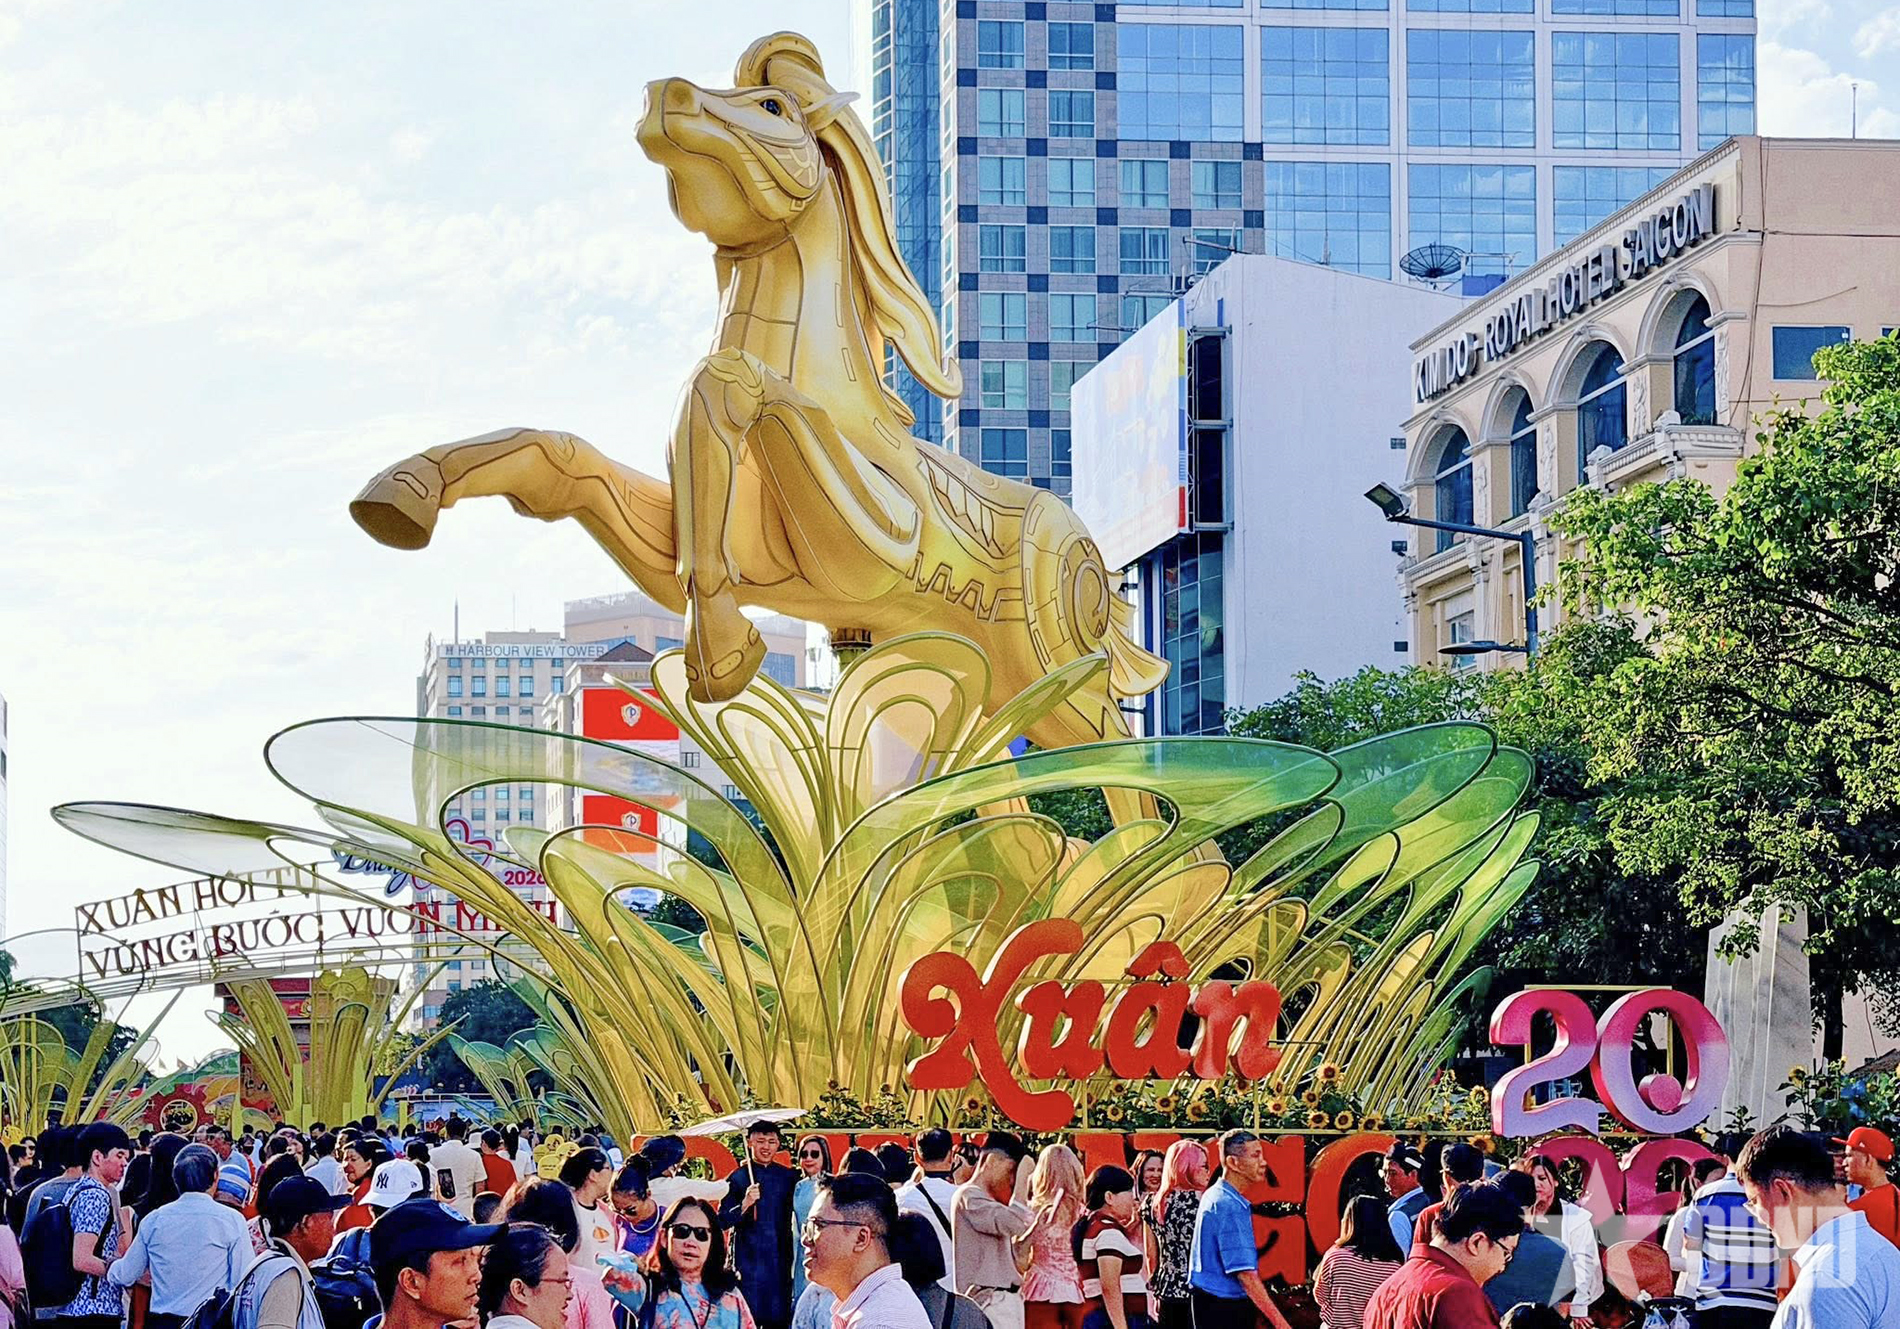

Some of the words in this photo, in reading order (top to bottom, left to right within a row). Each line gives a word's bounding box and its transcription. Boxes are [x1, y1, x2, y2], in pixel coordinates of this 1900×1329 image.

[1415, 349, 1446, 403] KIM
[1447, 333, 1474, 386] DO
[1483, 288, 1547, 363] ROYAL
[1548, 245, 1614, 323] HOTEL
[1620, 183, 1714, 280] SAIGON
[458, 645, 520, 657] HARBOUR
[523, 645, 555, 657] VIEW
[560, 645, 605, 657] TOWER
[77, 886, 182, 936] XUÂN
[900, 917, 1282, 1130] Xuân
[1489, 989, 1729, 1138] 20
